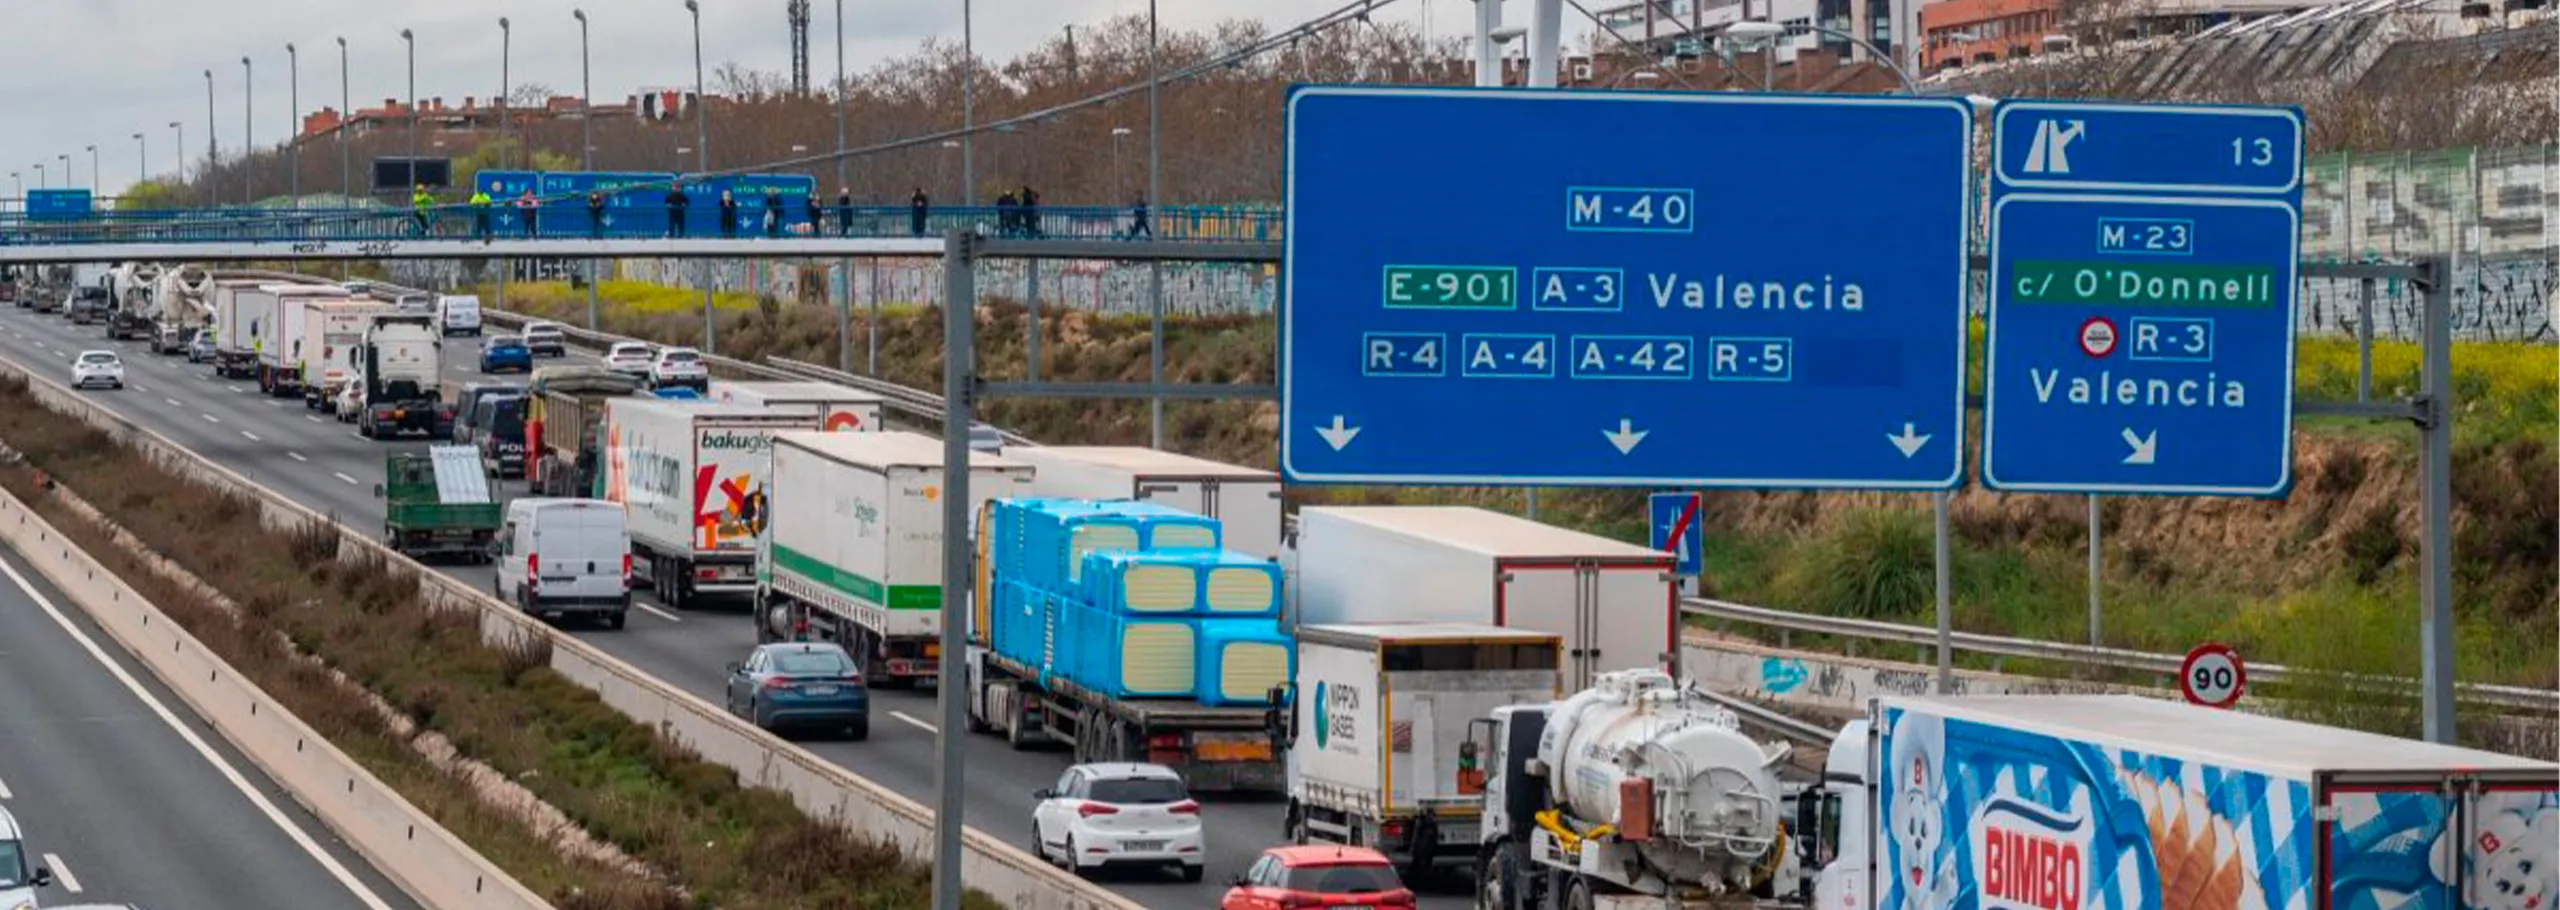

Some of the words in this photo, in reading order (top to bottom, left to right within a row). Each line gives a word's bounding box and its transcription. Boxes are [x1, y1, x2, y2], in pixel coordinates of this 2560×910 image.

[2232, 137, 2272, 166] 13
[1574, 195, 1686, 223] M-40
[2103, 225, 2187, 249] M-23
[1391, 272, 1511, 301] E-901
[1542, 275, 1615, 302] A-3
[1648, 272, 1864, 309] Valencia
[2018, 273, 2053, 296] c/
[2075, 270, 2269, 302] O'Donnell
[2137, 324, 2205, 352] R-3
[1370, 341, 1439, 369] R-4
[1471, 341, 1547, 370] A-4
[1580, 342, 1685, 371] A-42
[1716, 344, 1784, 373] R-5
[2031, 367, 2244, 407] Valencia
[499, 443, 525, 452] POL
[2195, 667, 2232, 690] 90
[1914, 756, 1923, 786] B
[1985, 826, 2080, 910] BIMBO
